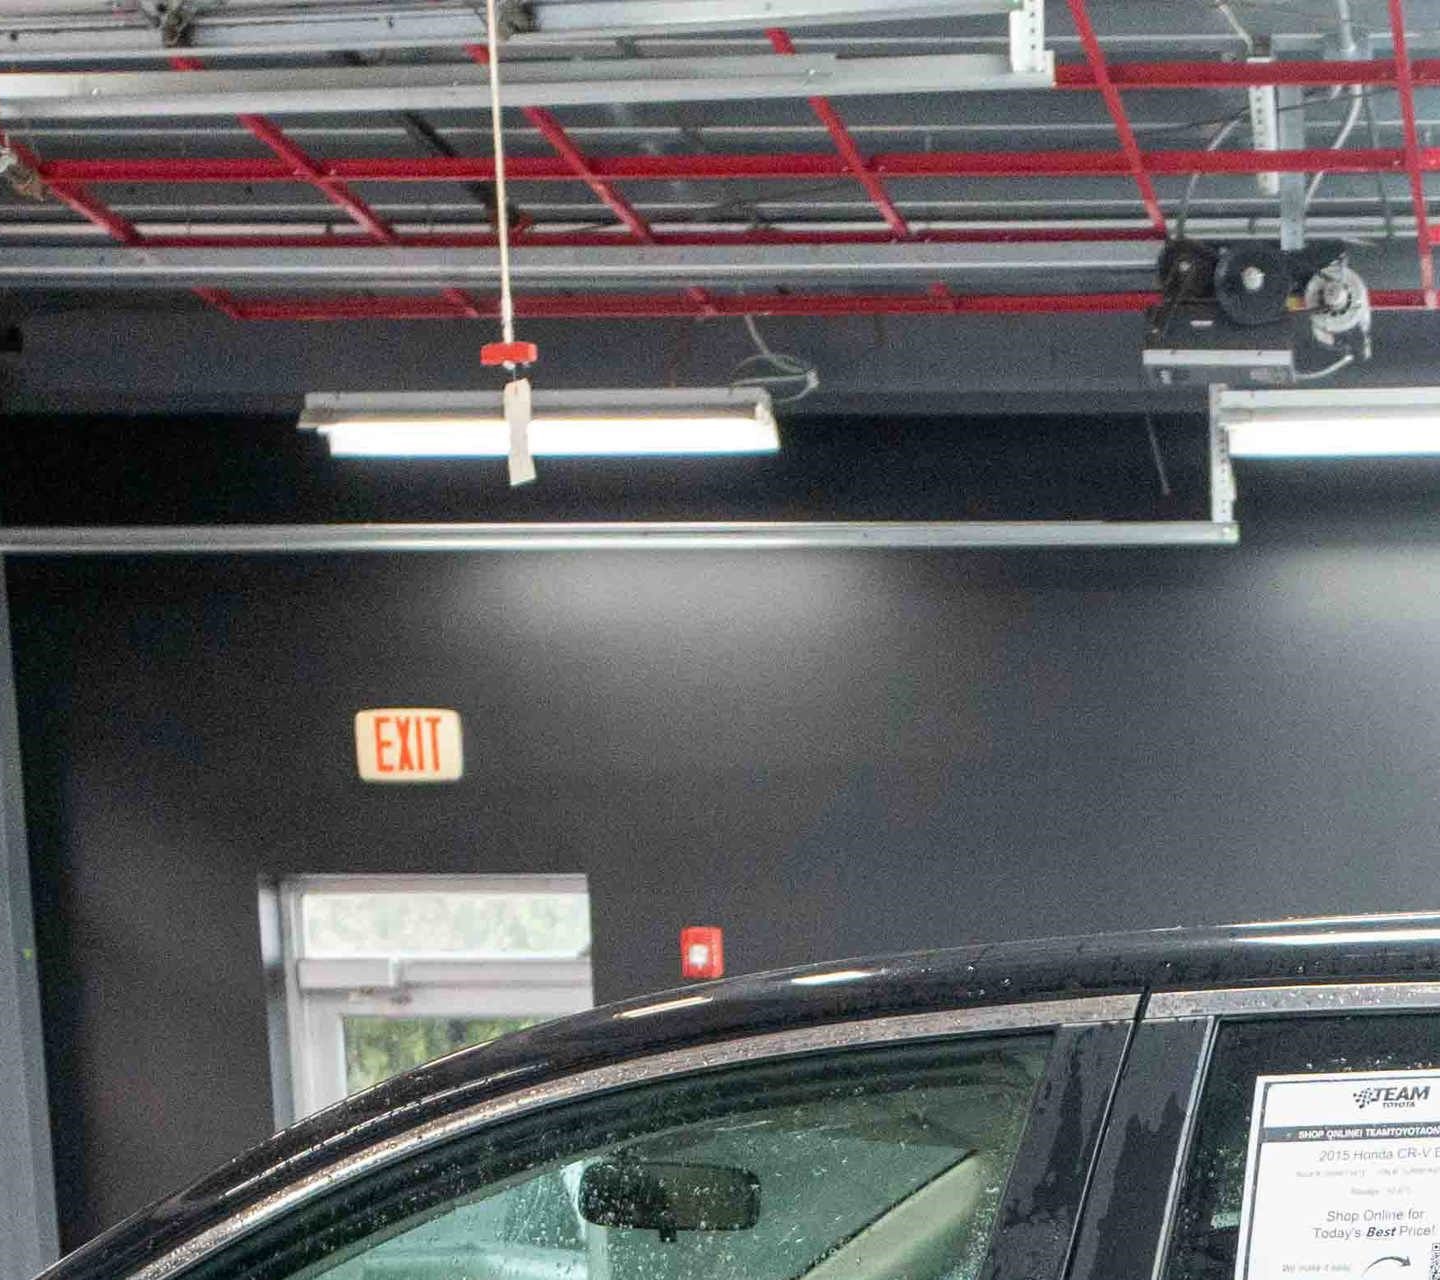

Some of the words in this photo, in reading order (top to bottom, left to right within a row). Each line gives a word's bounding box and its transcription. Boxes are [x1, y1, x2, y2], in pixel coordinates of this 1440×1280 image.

[374, 716, 442, 772] EXIT
[1371, 1086, 1430, 1102] TEAM
[1382, 1101, 1415, 1109] TOYOTA
[1298, 1130, 1325, 1139] SHOP
[1319, 1150, 1351, 1162] 2015
[1354, 1149, 1394, 1161] Honda
[1397, 1147, 1432, 1160] CR-V
[1327, 1210, 1359, 1223] Shop
[1363, 1209, 1403, 1221] Online
[1408, 1208, 1425, 1220] for
[1313, 1227, 1361, 1240] Today's
[1366, 1226, 1397, 1238] Best
[1400, 1224, 1436, 1237] Price!
